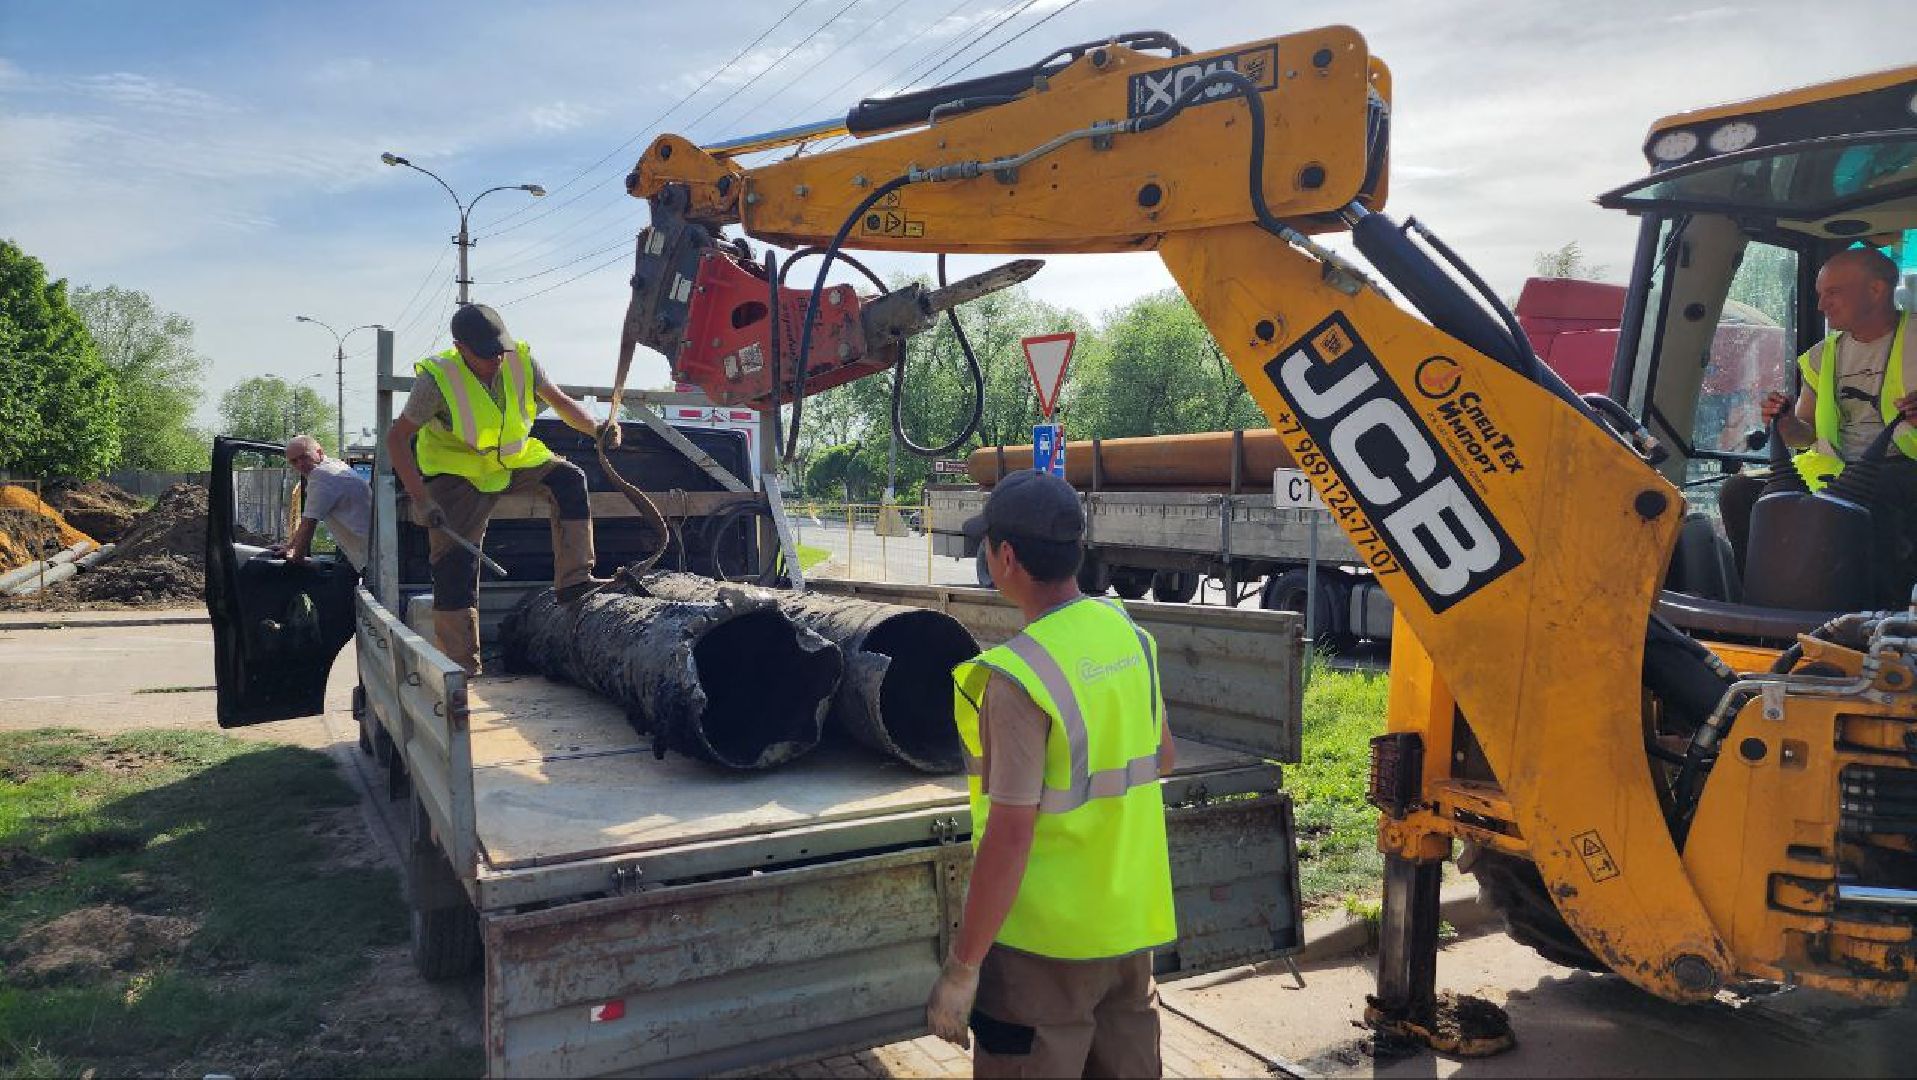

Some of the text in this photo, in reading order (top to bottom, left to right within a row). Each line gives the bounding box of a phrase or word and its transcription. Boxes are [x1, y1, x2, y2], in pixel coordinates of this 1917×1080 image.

[1279, 412, 1303, 436] +7
[1281, 349, 1500, 596] JCB
[1289, 477, 1312, 501] СТ
